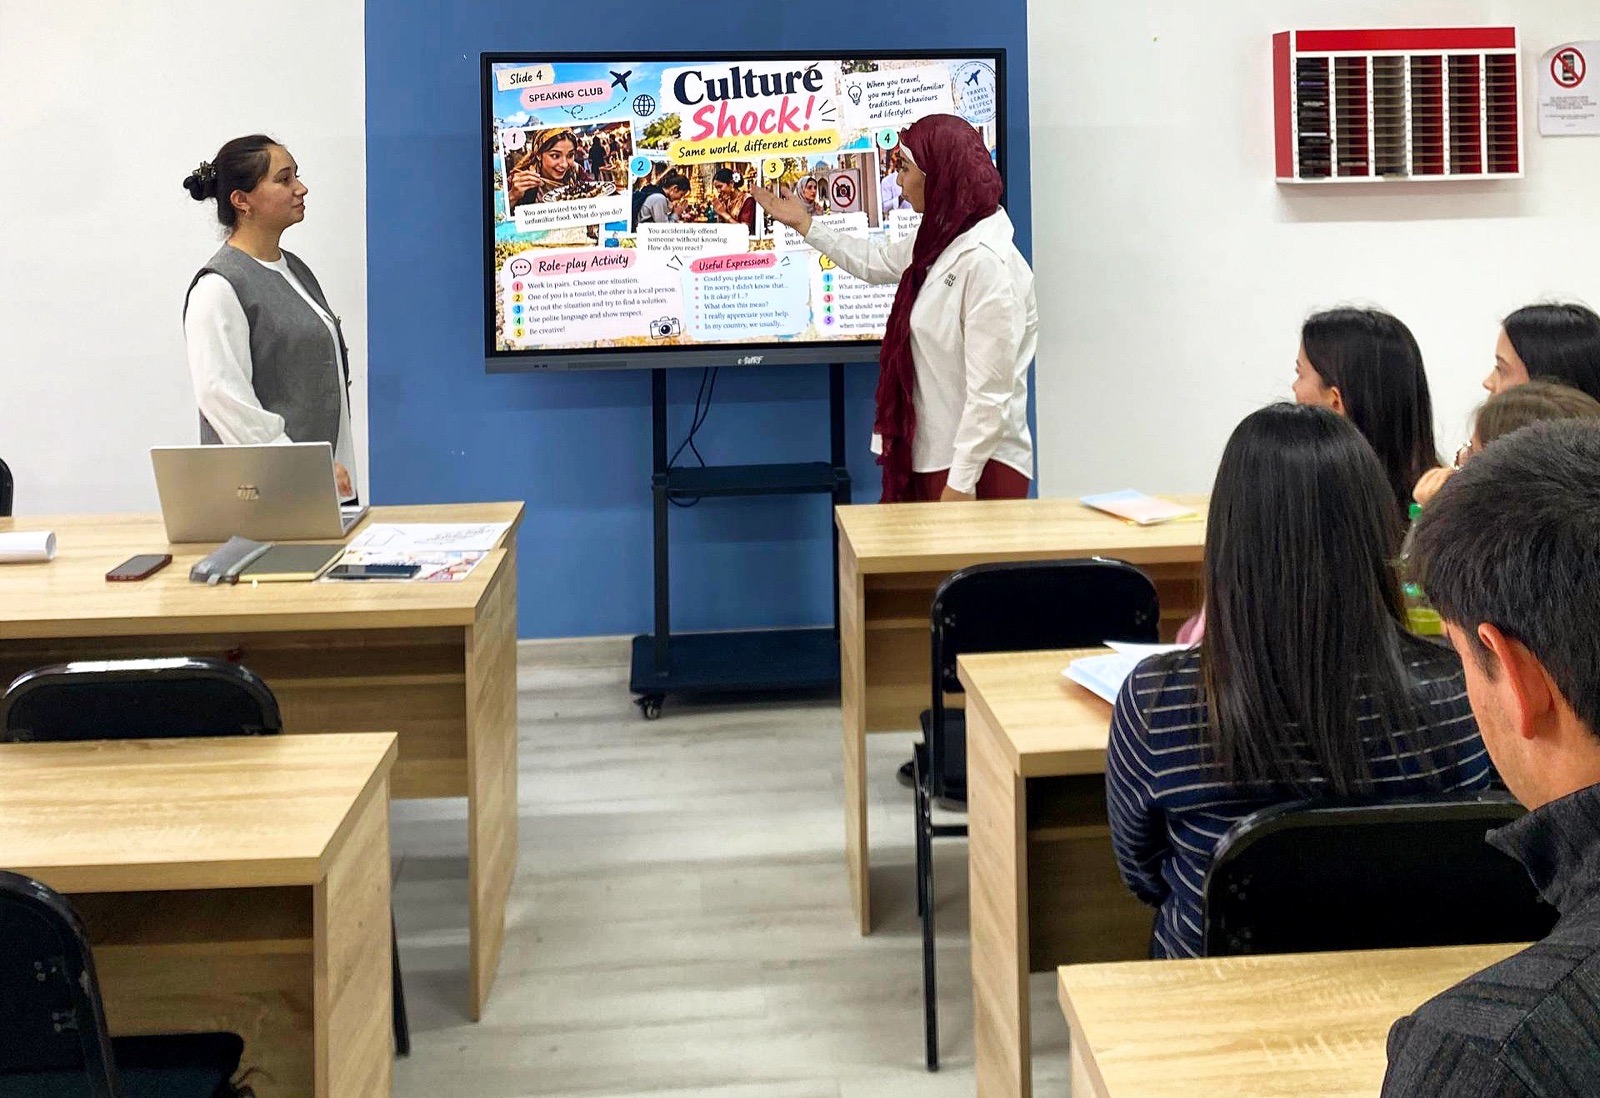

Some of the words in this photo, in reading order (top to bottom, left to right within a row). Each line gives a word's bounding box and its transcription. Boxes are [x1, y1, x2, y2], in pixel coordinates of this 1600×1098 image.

[510, 73, 533, 85] Slide
[536, 70, 543, 81] 4
[867, 80, 885, 89] When
[887, 80, 898, 88] you
[901, 75, 920, 84] travel,
[529, 90, 574, 102] SPEAKING
[578, 87, 603, 97] CLUB
[868, 93, 879, 101] you
[882, 90, 895, 98] may
[897, 87, 910, 95] face
[912, 82, 945, 93] unfamiliar
[905, 95, 938, 104] behaviours
[691, 95, 816, 142] Shock!
[870, 110, 882, 119] and
[512, 133, 516, 144] 1
[884, 133, 891, 143] 4
[679, 146, 706, 158] Same
[710, 142, 740, 155] world,
[744, 138, 789, 152] different
[793, 136, 832, 147] customs
[638, 161, 644, 171] 2
[770, 162, 777, 173] 3
[548, 206, 569, 214] invited
[539, 258, 587, 273] Role-play
[591, 254, 629, 268] Activity
[699, 261, 723, 271] Useful
[726, 256, 770, 270] Expressions
[555, 281, 571, 289] pairs.
[575, 290, 597, 298] tourist,
[542, 315, 559, 324] polite
[709, 312, 725, 320] really
[727, 312, 758, 320] appreciate
[539, 326, 566, 335] creative!
